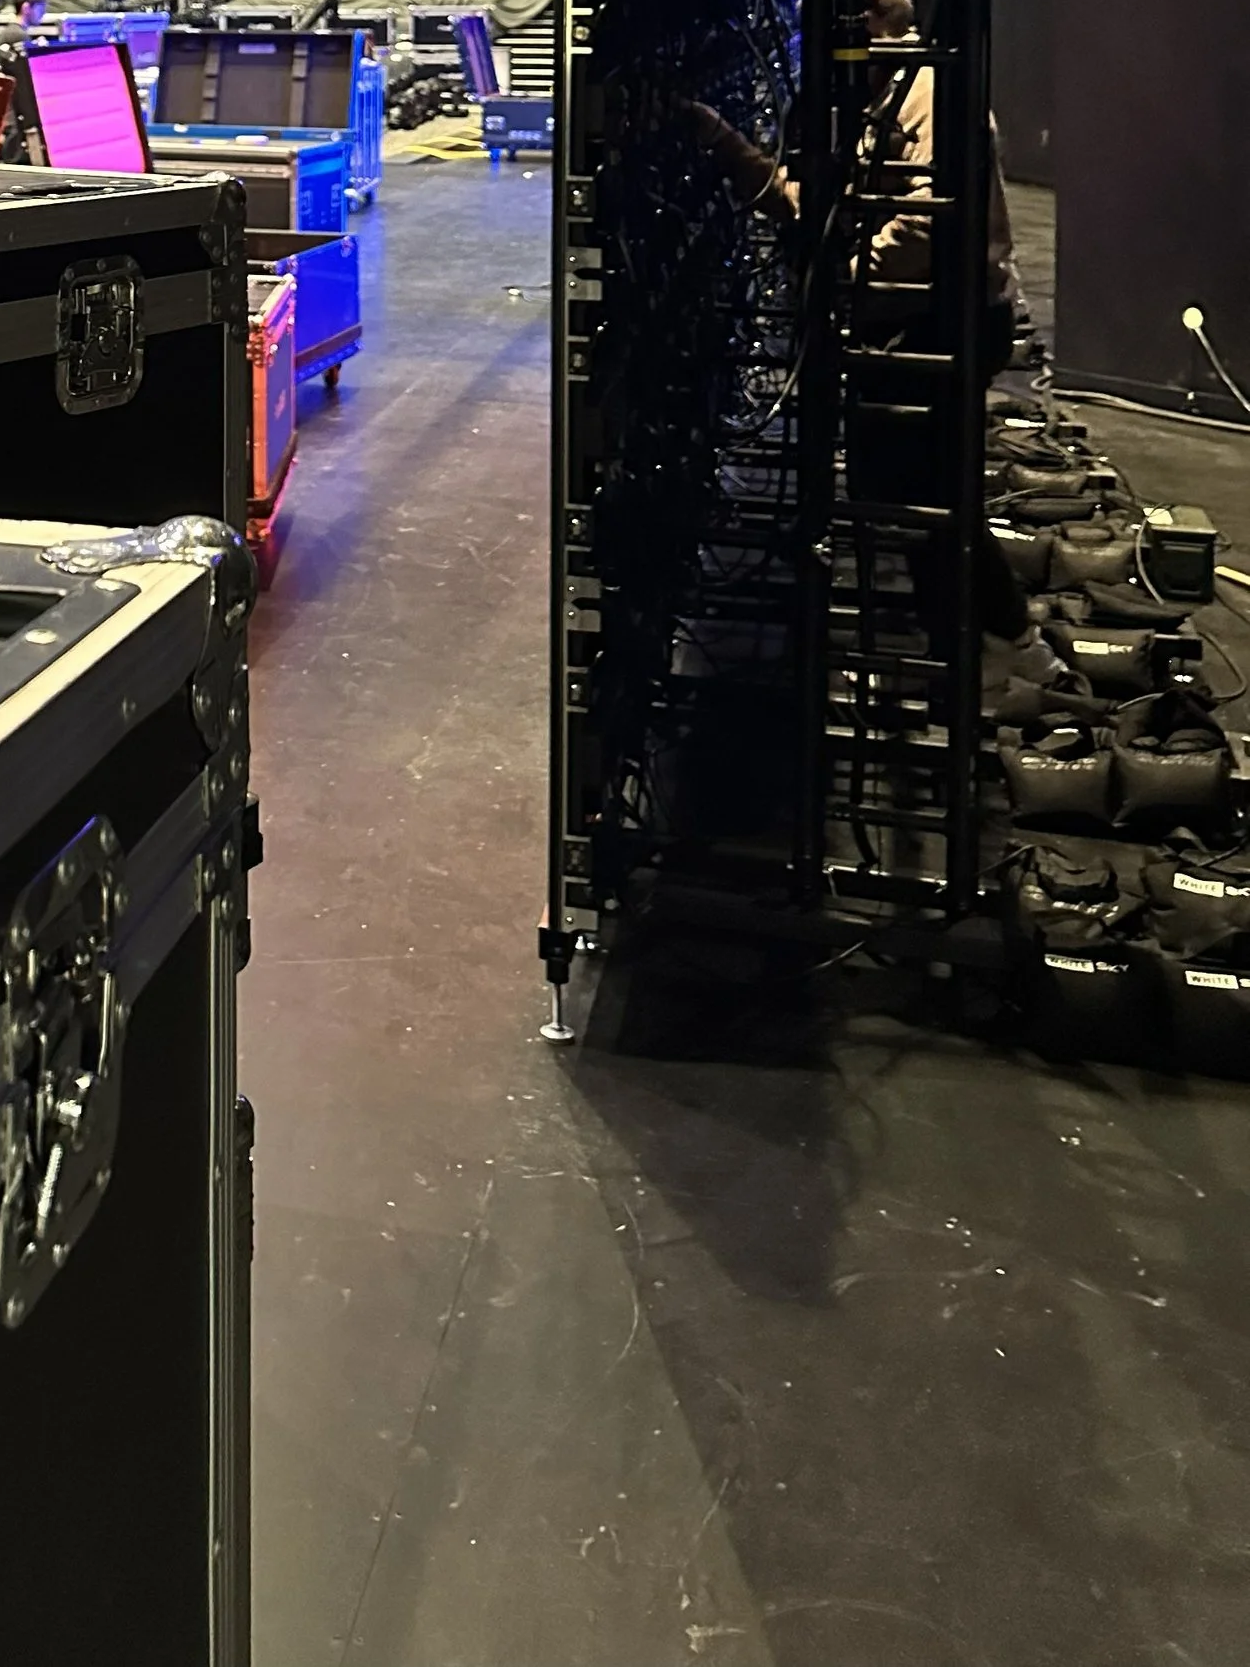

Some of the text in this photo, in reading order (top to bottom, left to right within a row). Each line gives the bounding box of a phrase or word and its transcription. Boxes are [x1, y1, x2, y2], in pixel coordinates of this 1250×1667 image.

[1178, 878, 1217, 892] WHITE
[1049, 955, 1129, 973] WHITE SKY
[1191, 975, 1230, 986] WHITE
